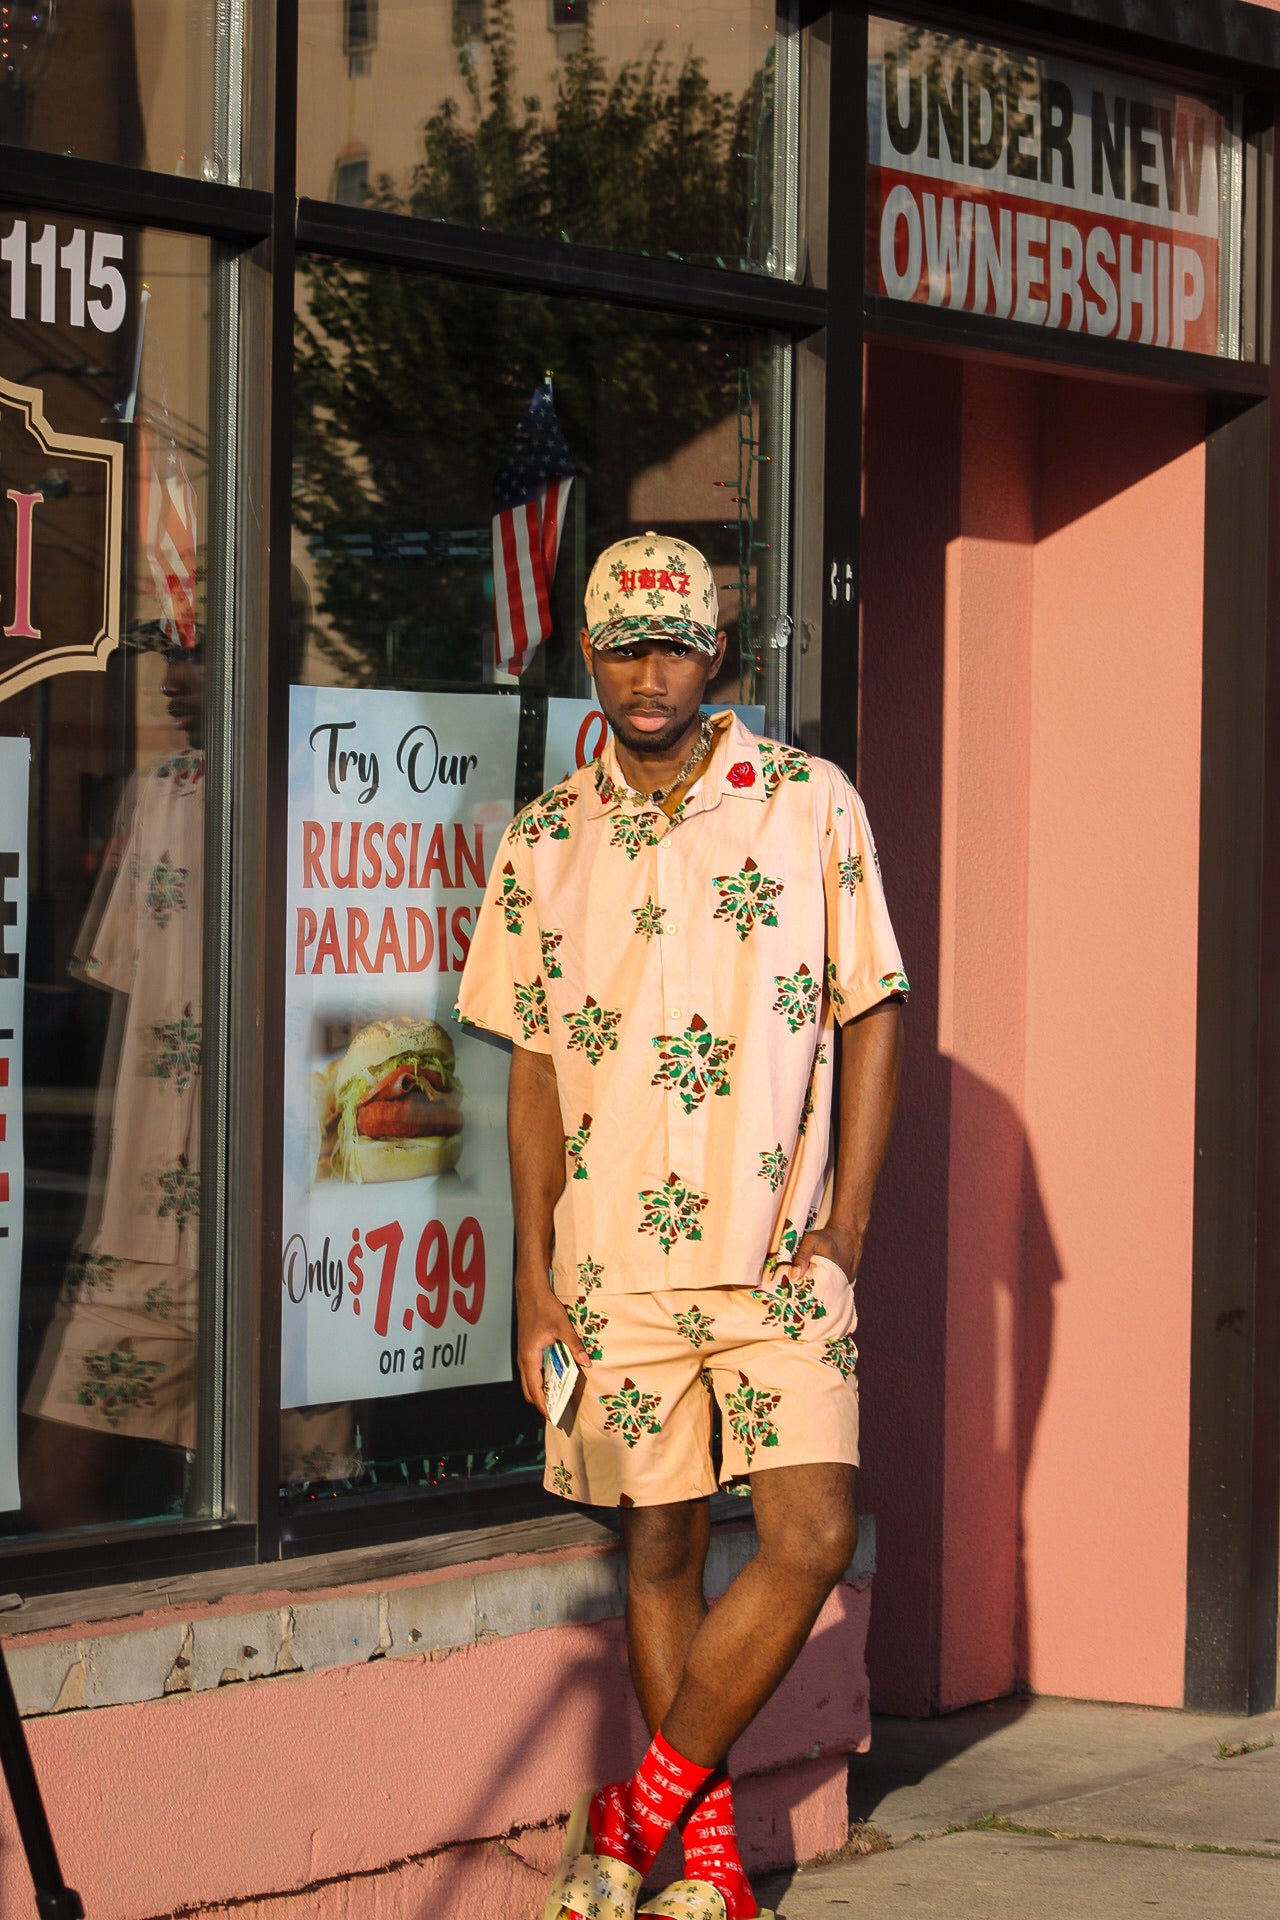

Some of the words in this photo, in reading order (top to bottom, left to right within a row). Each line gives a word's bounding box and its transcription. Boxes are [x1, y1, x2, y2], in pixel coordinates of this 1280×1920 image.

[884, 46, 1076, 190] UNDER
[1091, 88, 1224, 218] NEW
[1, 219, 127, 333] 1115
[880, 183, 1206, 351] OWNERSHIP
[309, 721, 380, 804] Try
[396, 724, 478, 794] Our
[302, 820, 487, 889] RUSSIAN
[294, 905, 482, 975] PARADIS
[282, 1233, 344, 1312] Only
[348, 1216, 486, 1337] $7.99
[379, 1348, 405, 1375] on
[412, 1346, 425, 1371] a
[431, 1333, 468, 1369] roll
